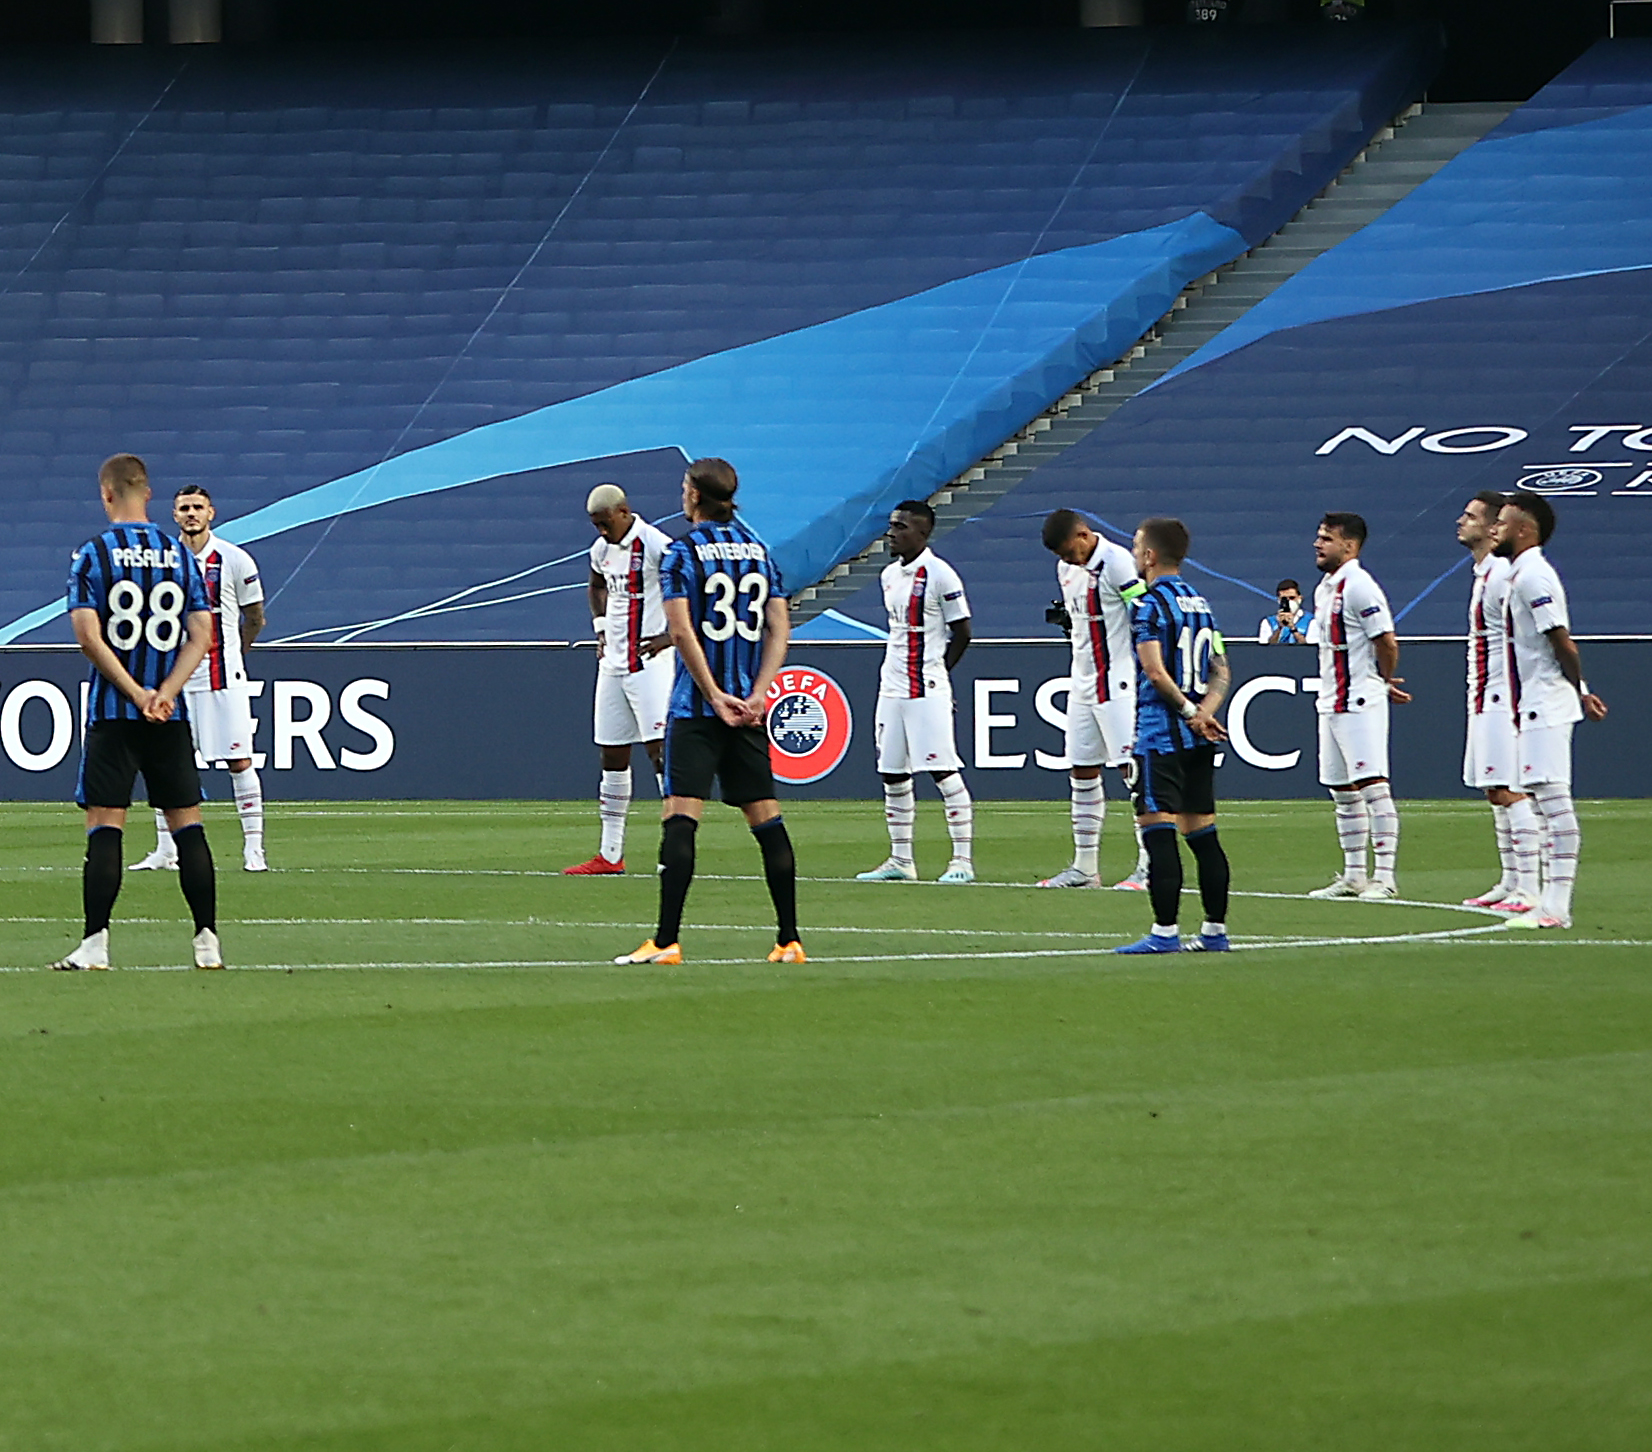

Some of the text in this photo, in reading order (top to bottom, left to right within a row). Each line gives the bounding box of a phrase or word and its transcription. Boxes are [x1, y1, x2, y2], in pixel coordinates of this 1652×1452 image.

[1314, 425, 1528, 455] NO
[107, 579, 185, 652] 88
[701, 572, 769, 642] 33
[766, 674, 827, 701] UEFA
[1177, 626, 1213, 695] 10
